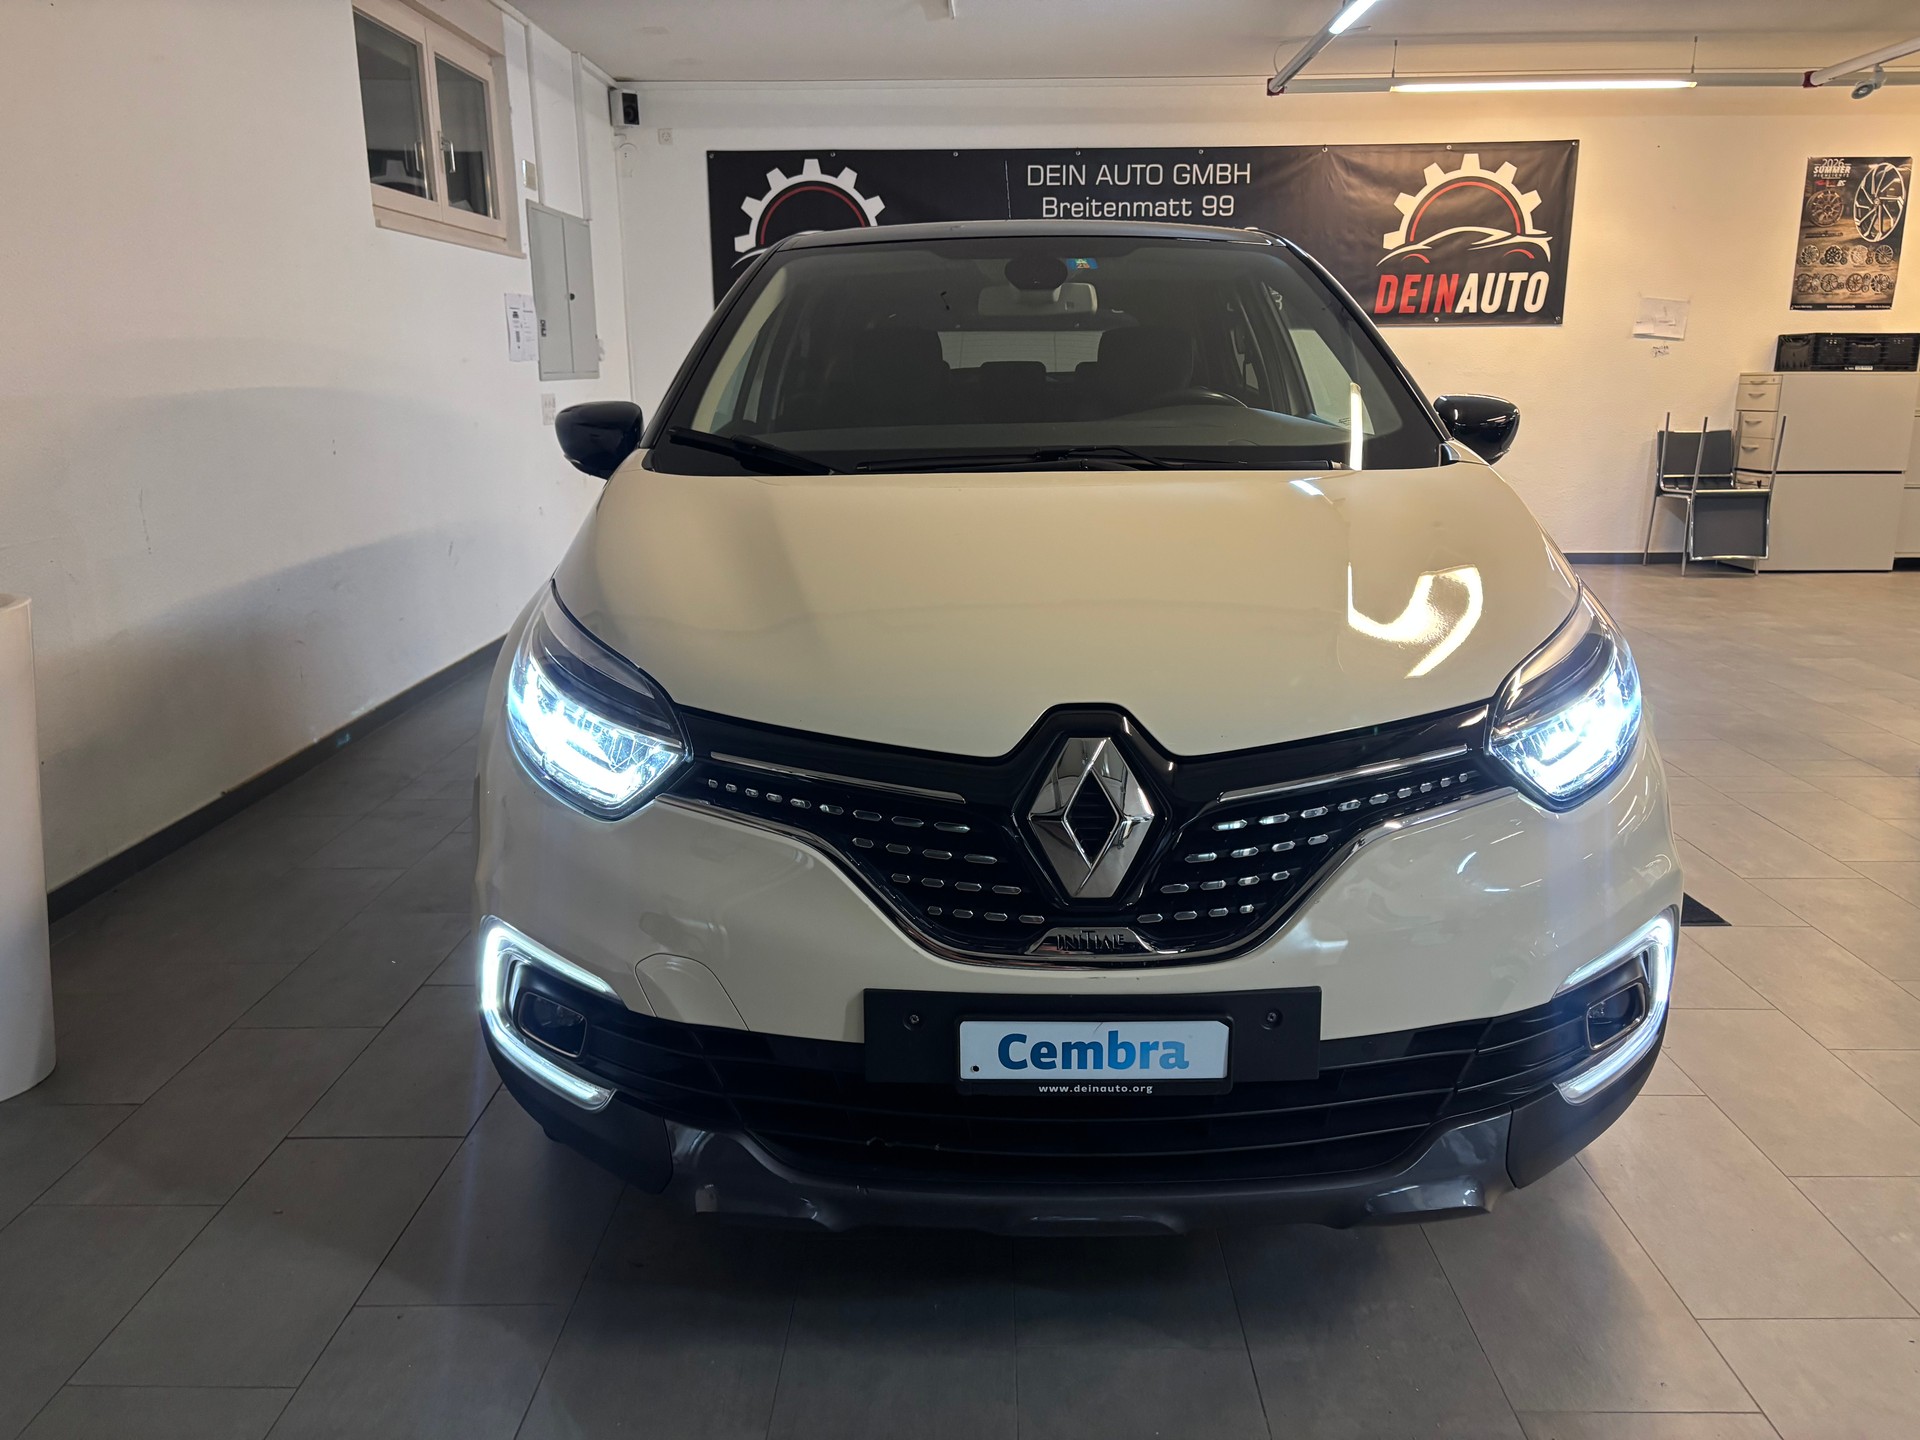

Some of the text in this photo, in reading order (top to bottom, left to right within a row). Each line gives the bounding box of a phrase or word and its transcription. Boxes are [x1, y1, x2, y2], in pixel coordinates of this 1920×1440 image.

[1813, 165, 1851, 174] SUMMER
[1821, 158, 1845, 167] 2026
[1027, 163, 1251, 186] DEIN AUTO GMBH
[1042, 195, 1235, 217] Breitenmatt 99
[1374, 271, 1550, 314] DEINAUTO
[1056, 930, 1125, 951] INITIALE
[997, 1030, 1190, 1071] Cembra
[1038, 1084, 1153, 1094] www.deinauto.org
